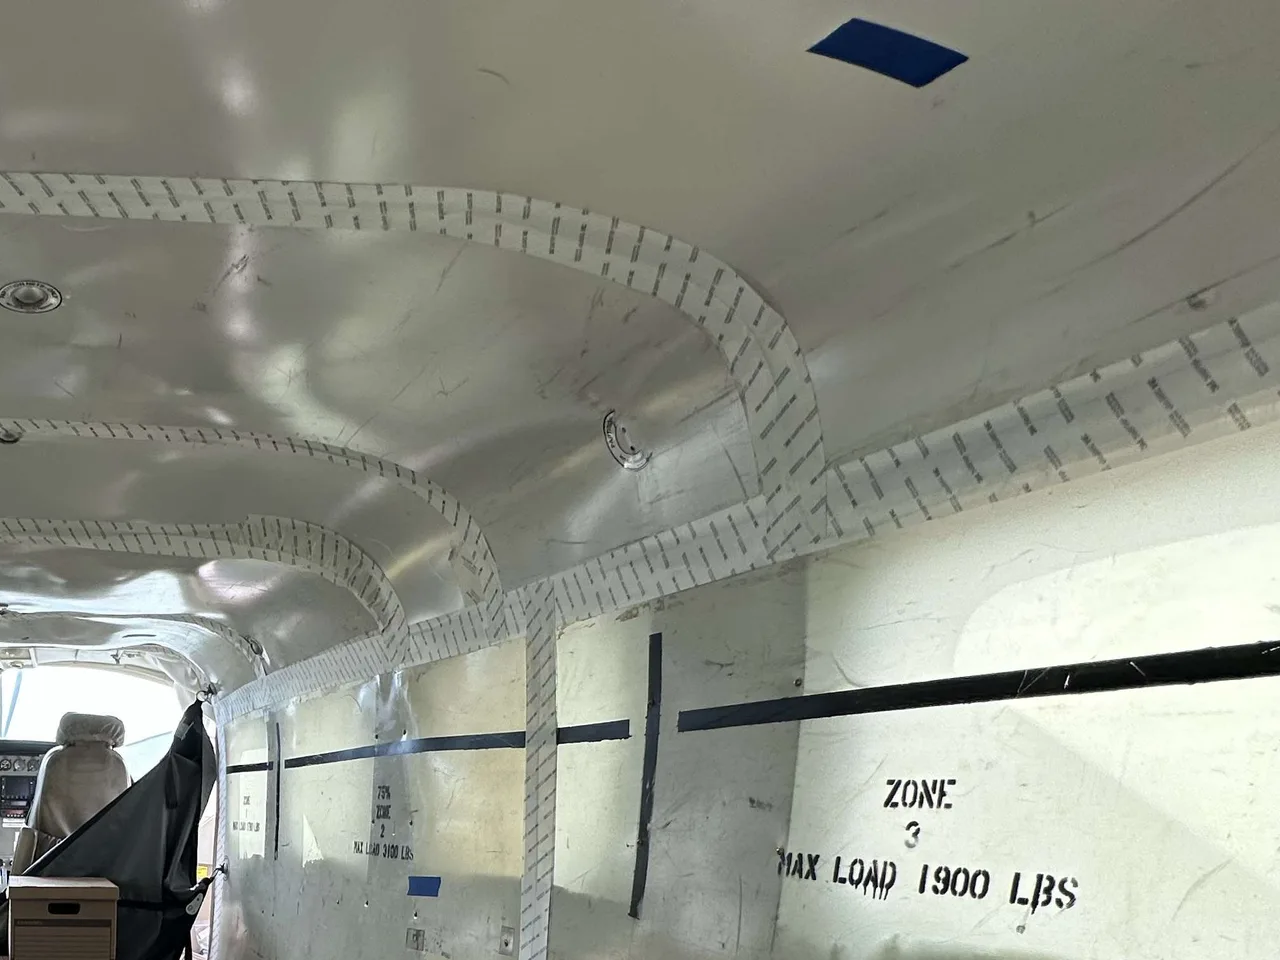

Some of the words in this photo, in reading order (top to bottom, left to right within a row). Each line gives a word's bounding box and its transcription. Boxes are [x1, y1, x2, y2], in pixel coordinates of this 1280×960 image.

[377, 785, 391, 800] 75%
[883, 778, 957, 809] ZONE
[375, 804, 391, 819] ZONE
[379, 823, 385, 838] 2
[904, 821, 921, 849] 3
[353, 840, 363, 854] MAX
[382, 843, 398, 858] 3100
[400, 845, 413, 860] LBS
[777, 848, 821, 881] MAX
[833, 855, 897, 893] LOAD
[918, 864, 990, 899] 1900
[1010, 871, 1079, 912] LBS
